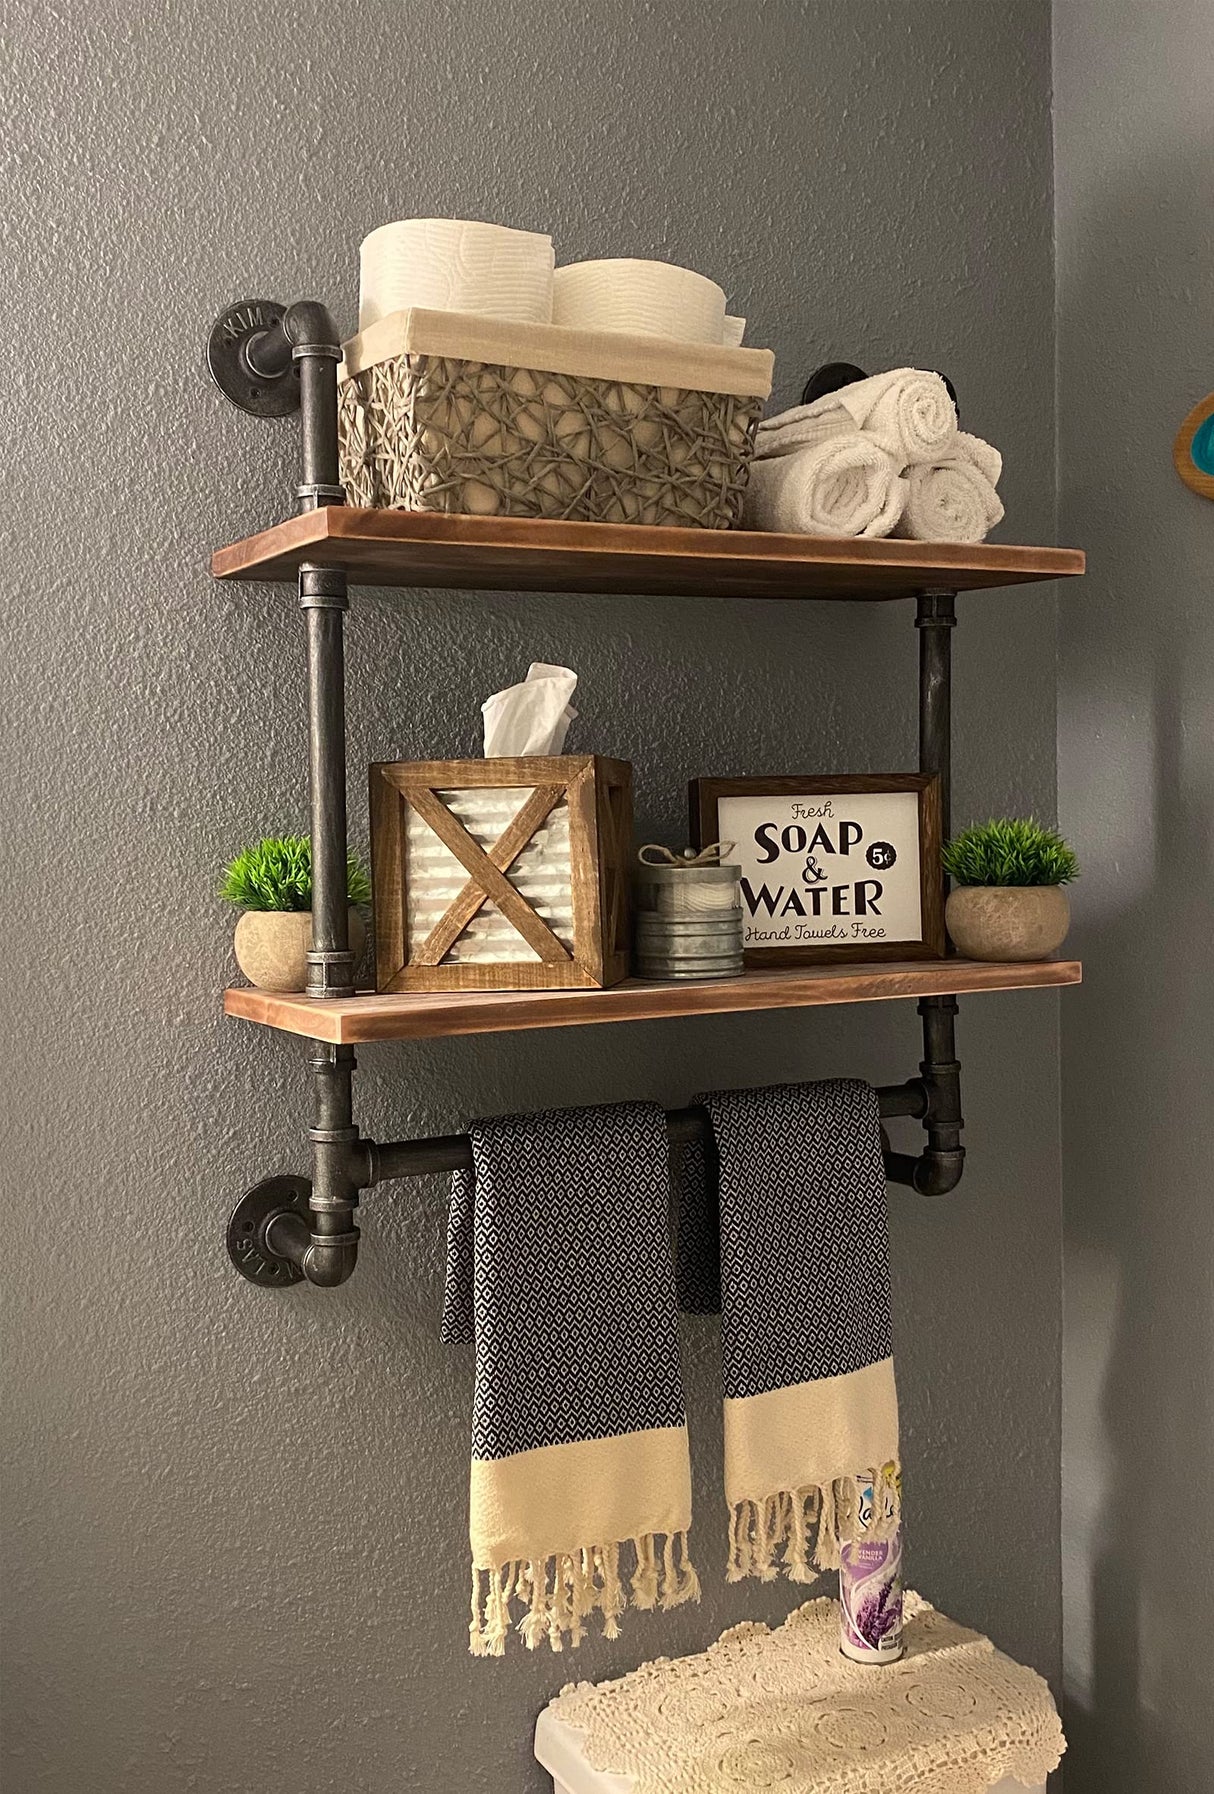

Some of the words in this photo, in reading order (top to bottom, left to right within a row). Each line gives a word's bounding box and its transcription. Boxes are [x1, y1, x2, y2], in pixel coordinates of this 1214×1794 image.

[791, 800, 835, 819] Fresh
[754, 821, 863, 864] SOAP
[872, 848, 892, 865] 5¢
[802, 856, 828, 884] &
[740, 877, 883, 917] WATER
[745, 926, 791, 942] Hand
[795, 924, 848, 940] Towels
[851, 922, 886, 939] Free
